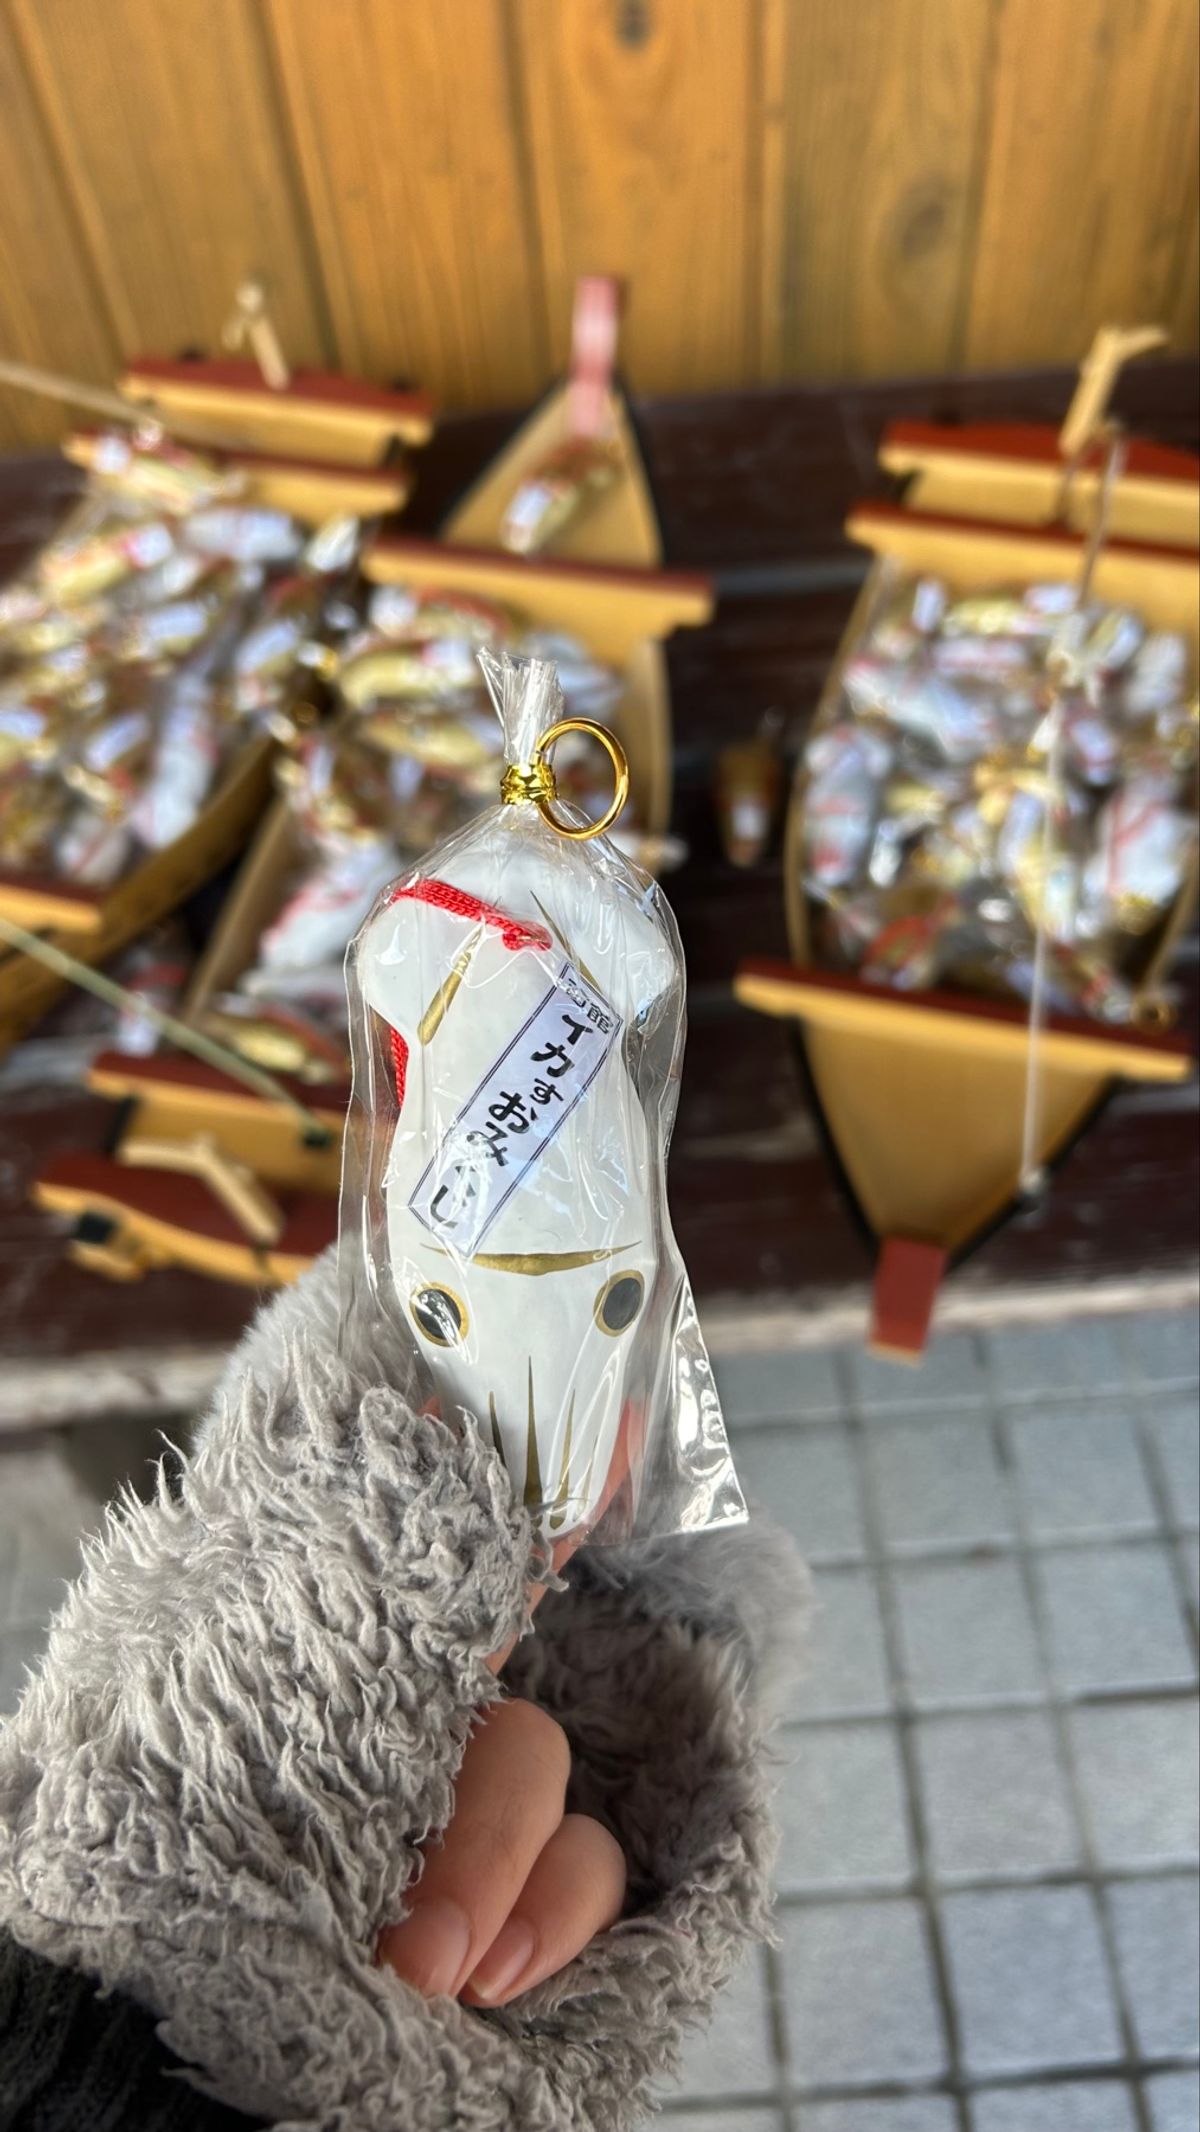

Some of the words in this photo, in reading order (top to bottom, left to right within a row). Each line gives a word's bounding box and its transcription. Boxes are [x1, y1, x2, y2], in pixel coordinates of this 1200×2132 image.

[430, 1014, 594, 1229] イカすおみじ
